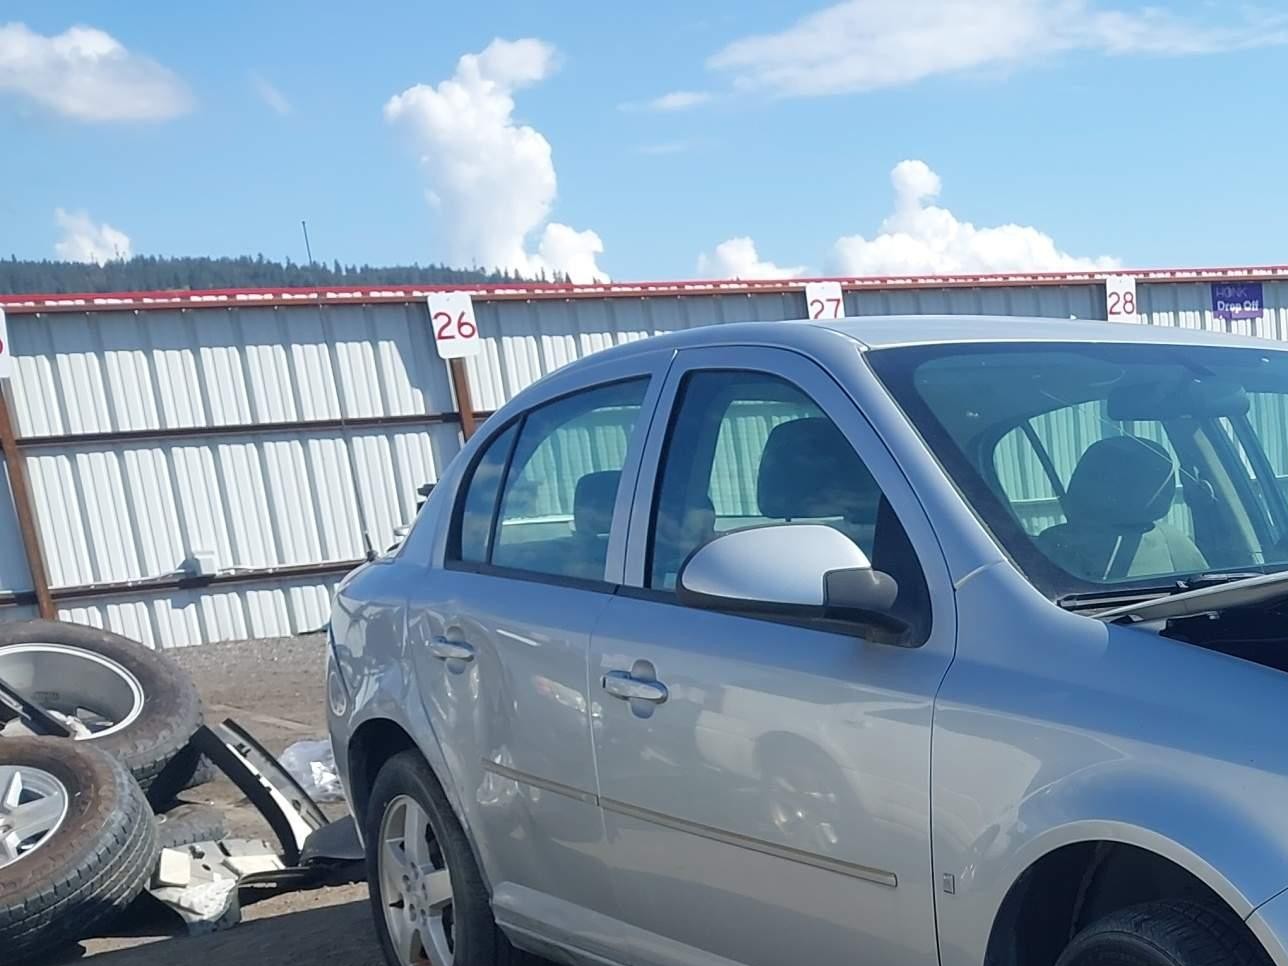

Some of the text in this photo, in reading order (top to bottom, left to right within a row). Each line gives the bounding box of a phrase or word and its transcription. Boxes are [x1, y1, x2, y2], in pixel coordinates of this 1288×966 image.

[1108, 290, 1135, 316] 28
[1215, 287, 1249, 299] HONK
[809, 297, 841, 320] 27
[1216, 299, 1259, 314] Drop Off
[433, 309, 476, 341] 26
